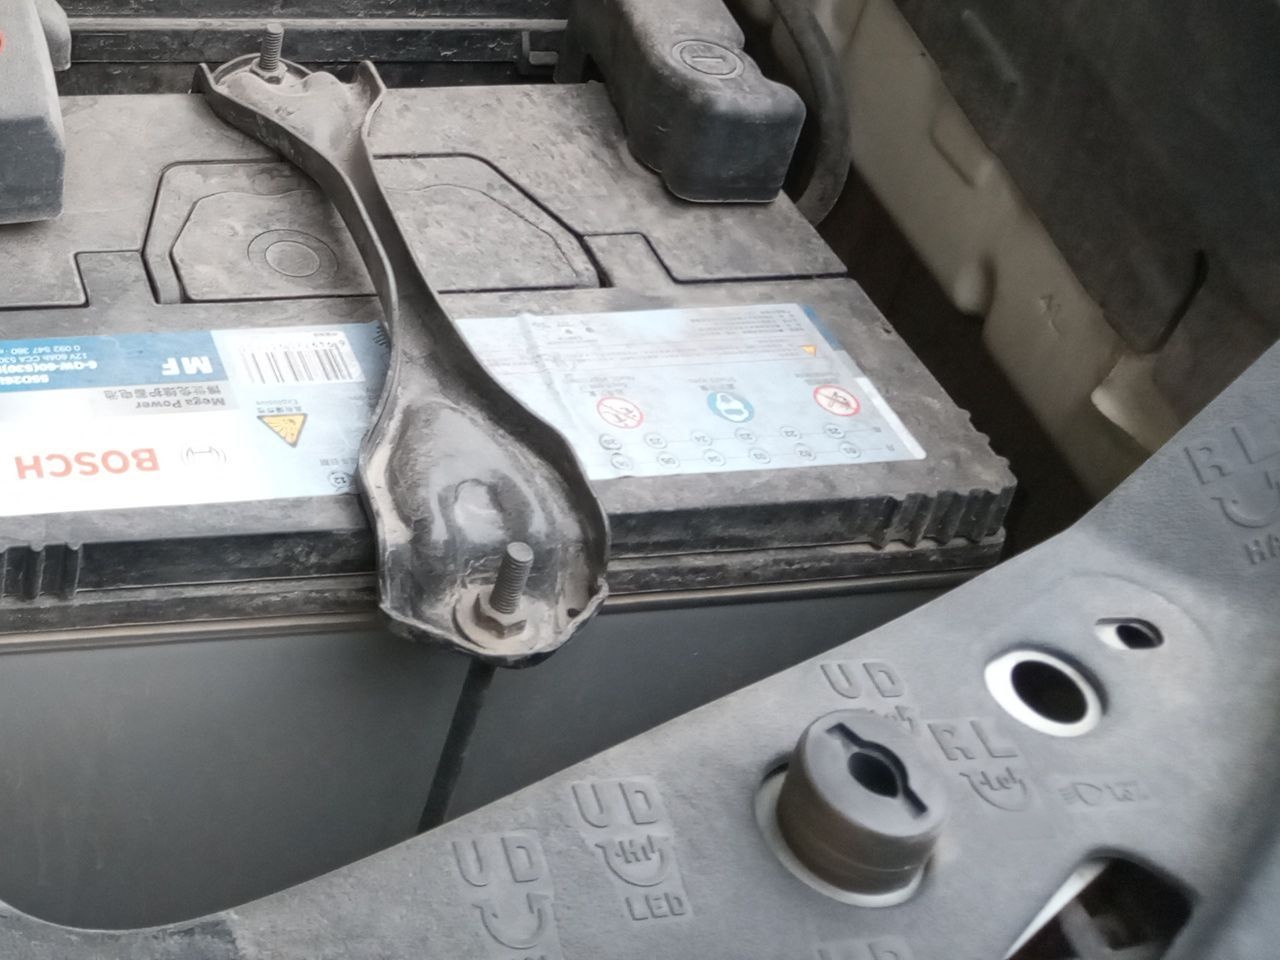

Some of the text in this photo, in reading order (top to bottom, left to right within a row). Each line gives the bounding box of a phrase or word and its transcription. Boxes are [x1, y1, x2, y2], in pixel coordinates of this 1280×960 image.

[18, 355, 41, 363] CCA
[69, 352, 88, 360] 12V
[161, 355, 214, 376] MF
[135, 396, 226, 410] Mega Power
[13, 447, 160, 481] BOSCH
[624, 892, 687, 923] LED
